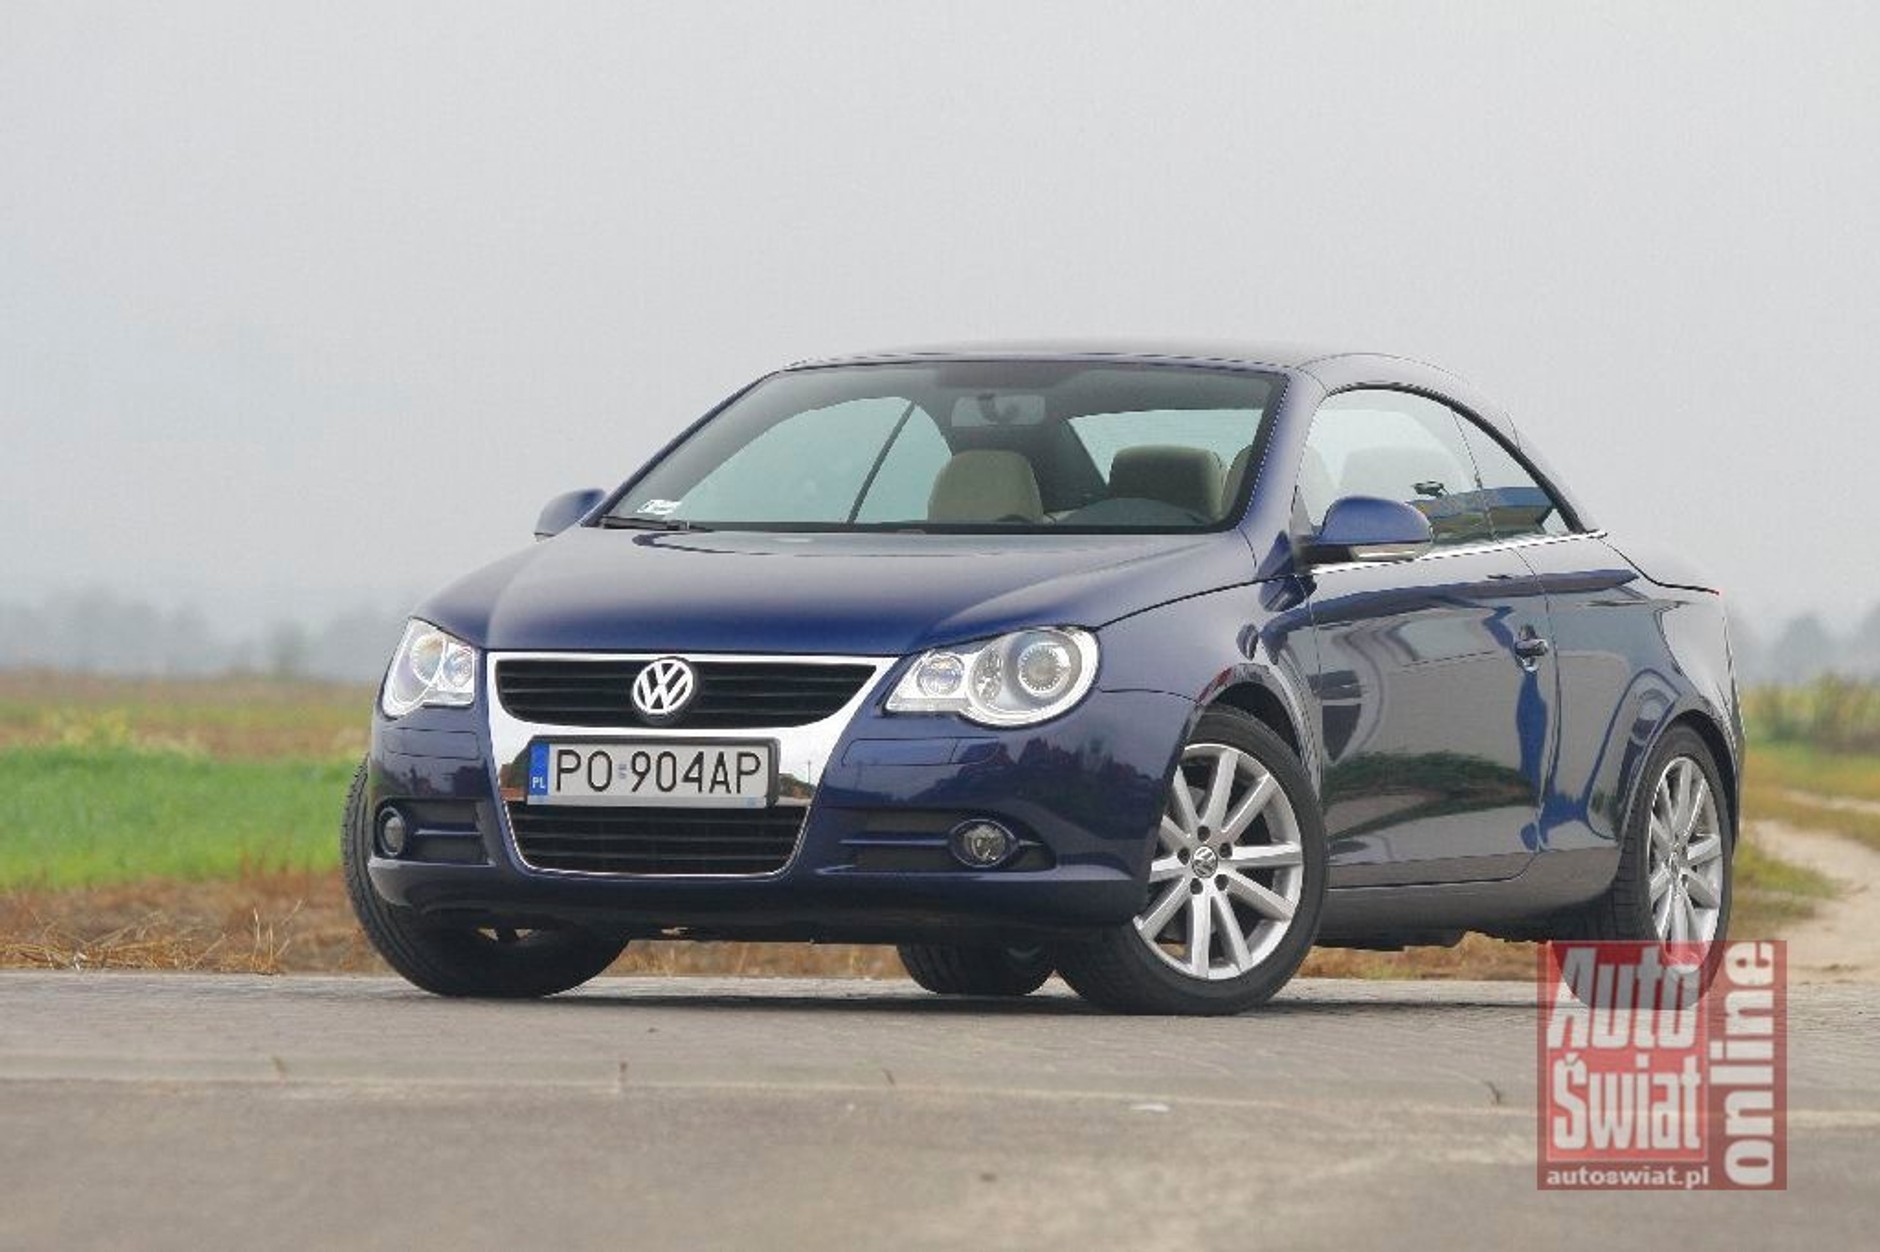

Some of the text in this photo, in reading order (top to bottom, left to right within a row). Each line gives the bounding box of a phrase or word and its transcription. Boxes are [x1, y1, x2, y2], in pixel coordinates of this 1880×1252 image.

[633, 658, 694, 714] VW
[532, 776, 546, 789] PL
[556, 749, 761, 793] PO 904AP
